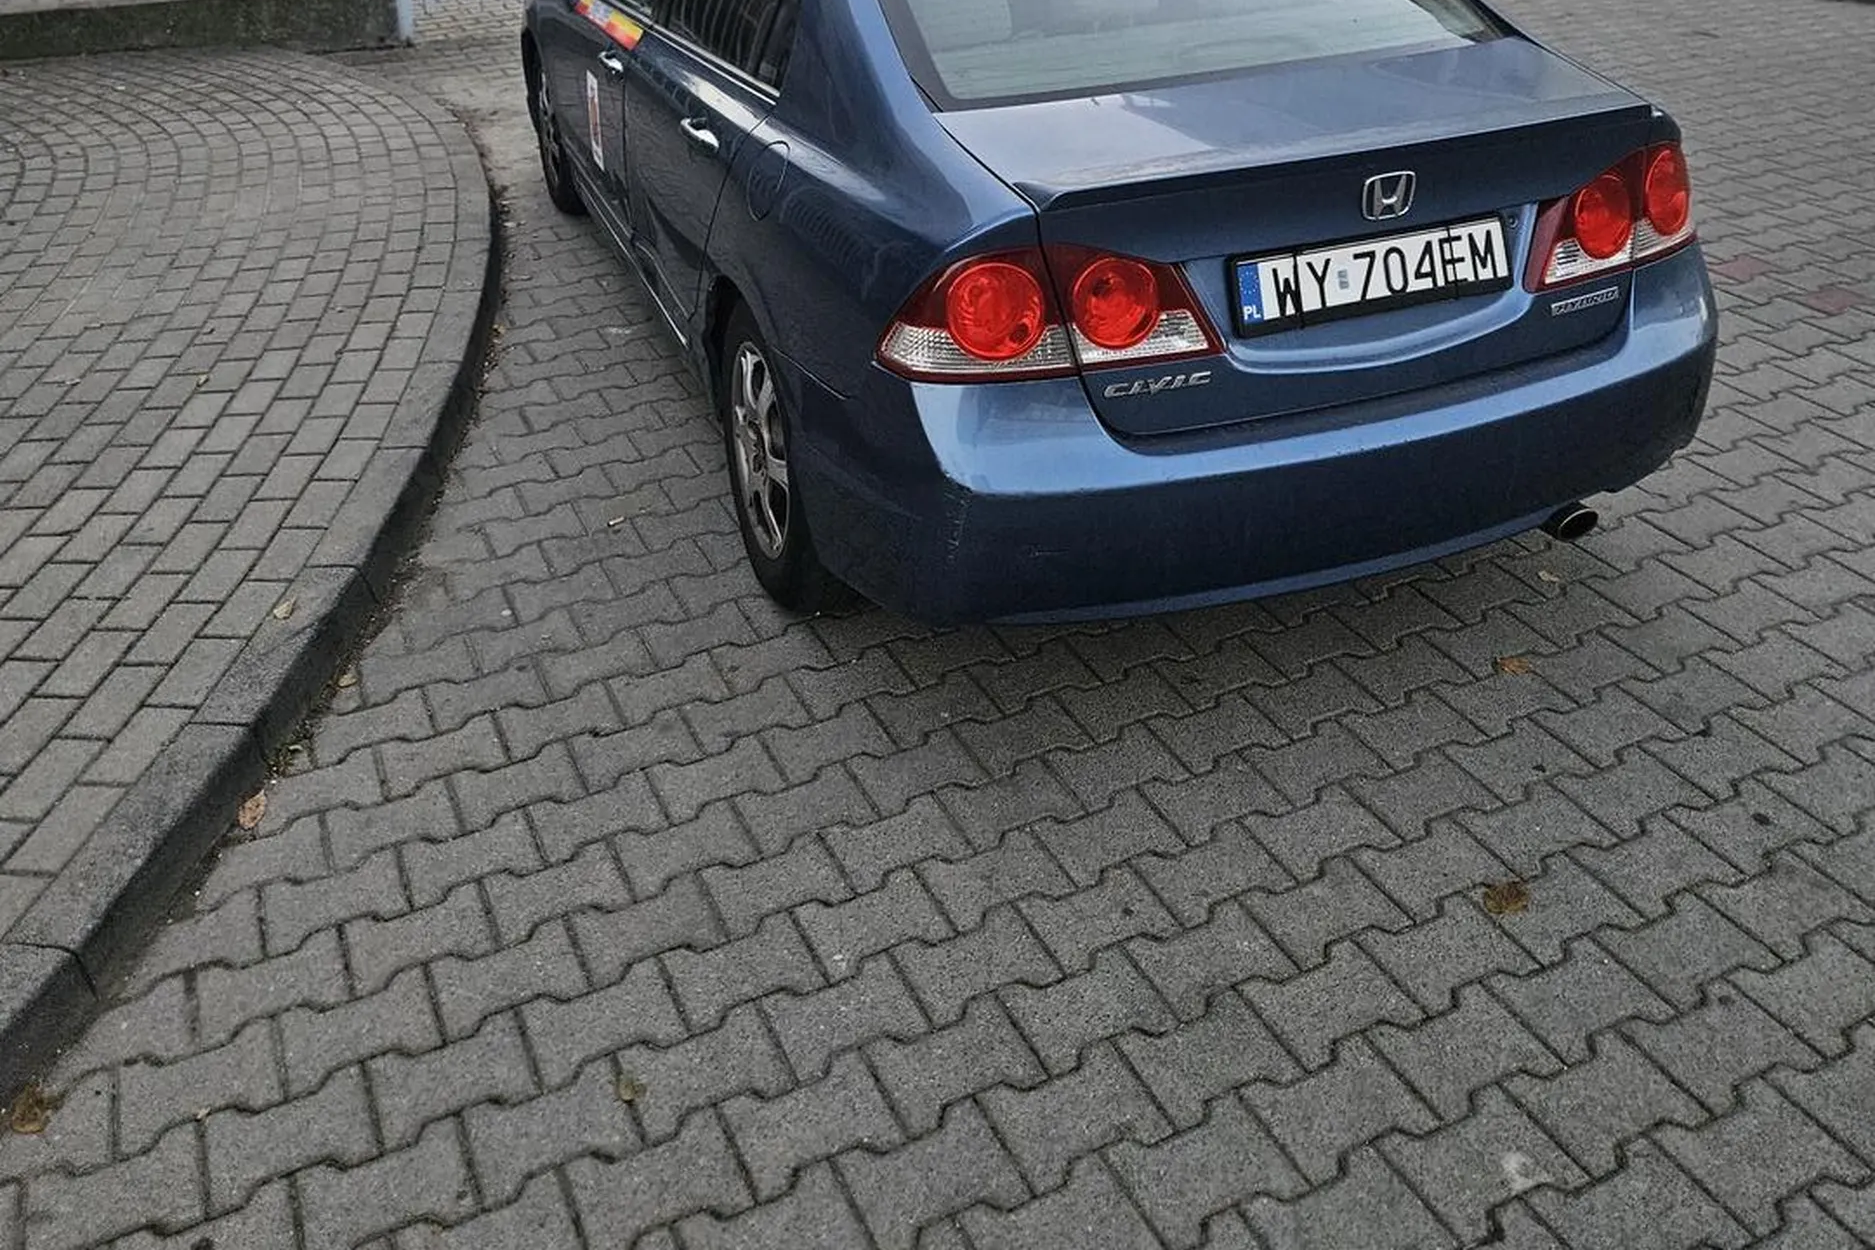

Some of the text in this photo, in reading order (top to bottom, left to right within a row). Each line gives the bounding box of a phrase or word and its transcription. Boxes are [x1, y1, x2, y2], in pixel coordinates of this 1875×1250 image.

[1271, 258, 1331, 317] WY
[1243, 305, 1262, 321] PL
[1103, 371, 1211, 398] CIVIC
